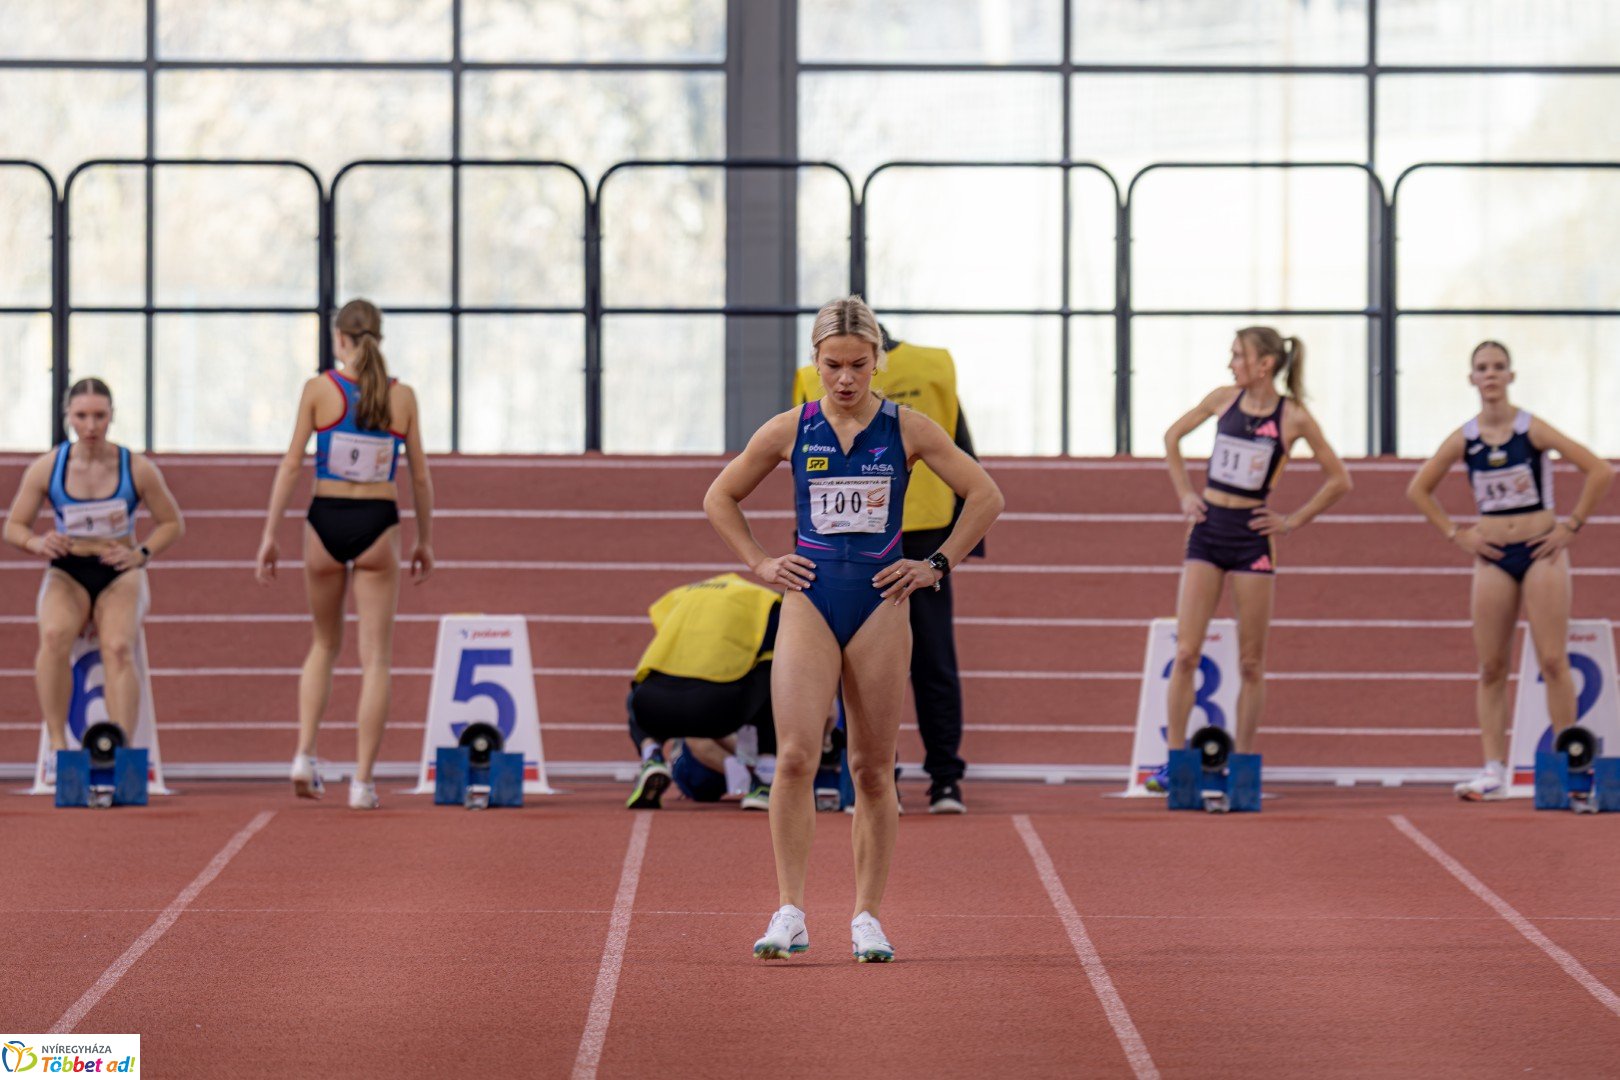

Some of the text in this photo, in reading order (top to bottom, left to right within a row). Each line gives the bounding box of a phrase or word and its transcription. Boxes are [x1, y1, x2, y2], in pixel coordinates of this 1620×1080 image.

[809, 459, 825, 469] SPP
[861, 464, 894, 472] NASA
[820, 491, 861, 515] 100
[450, 648, 517, 743] 5
